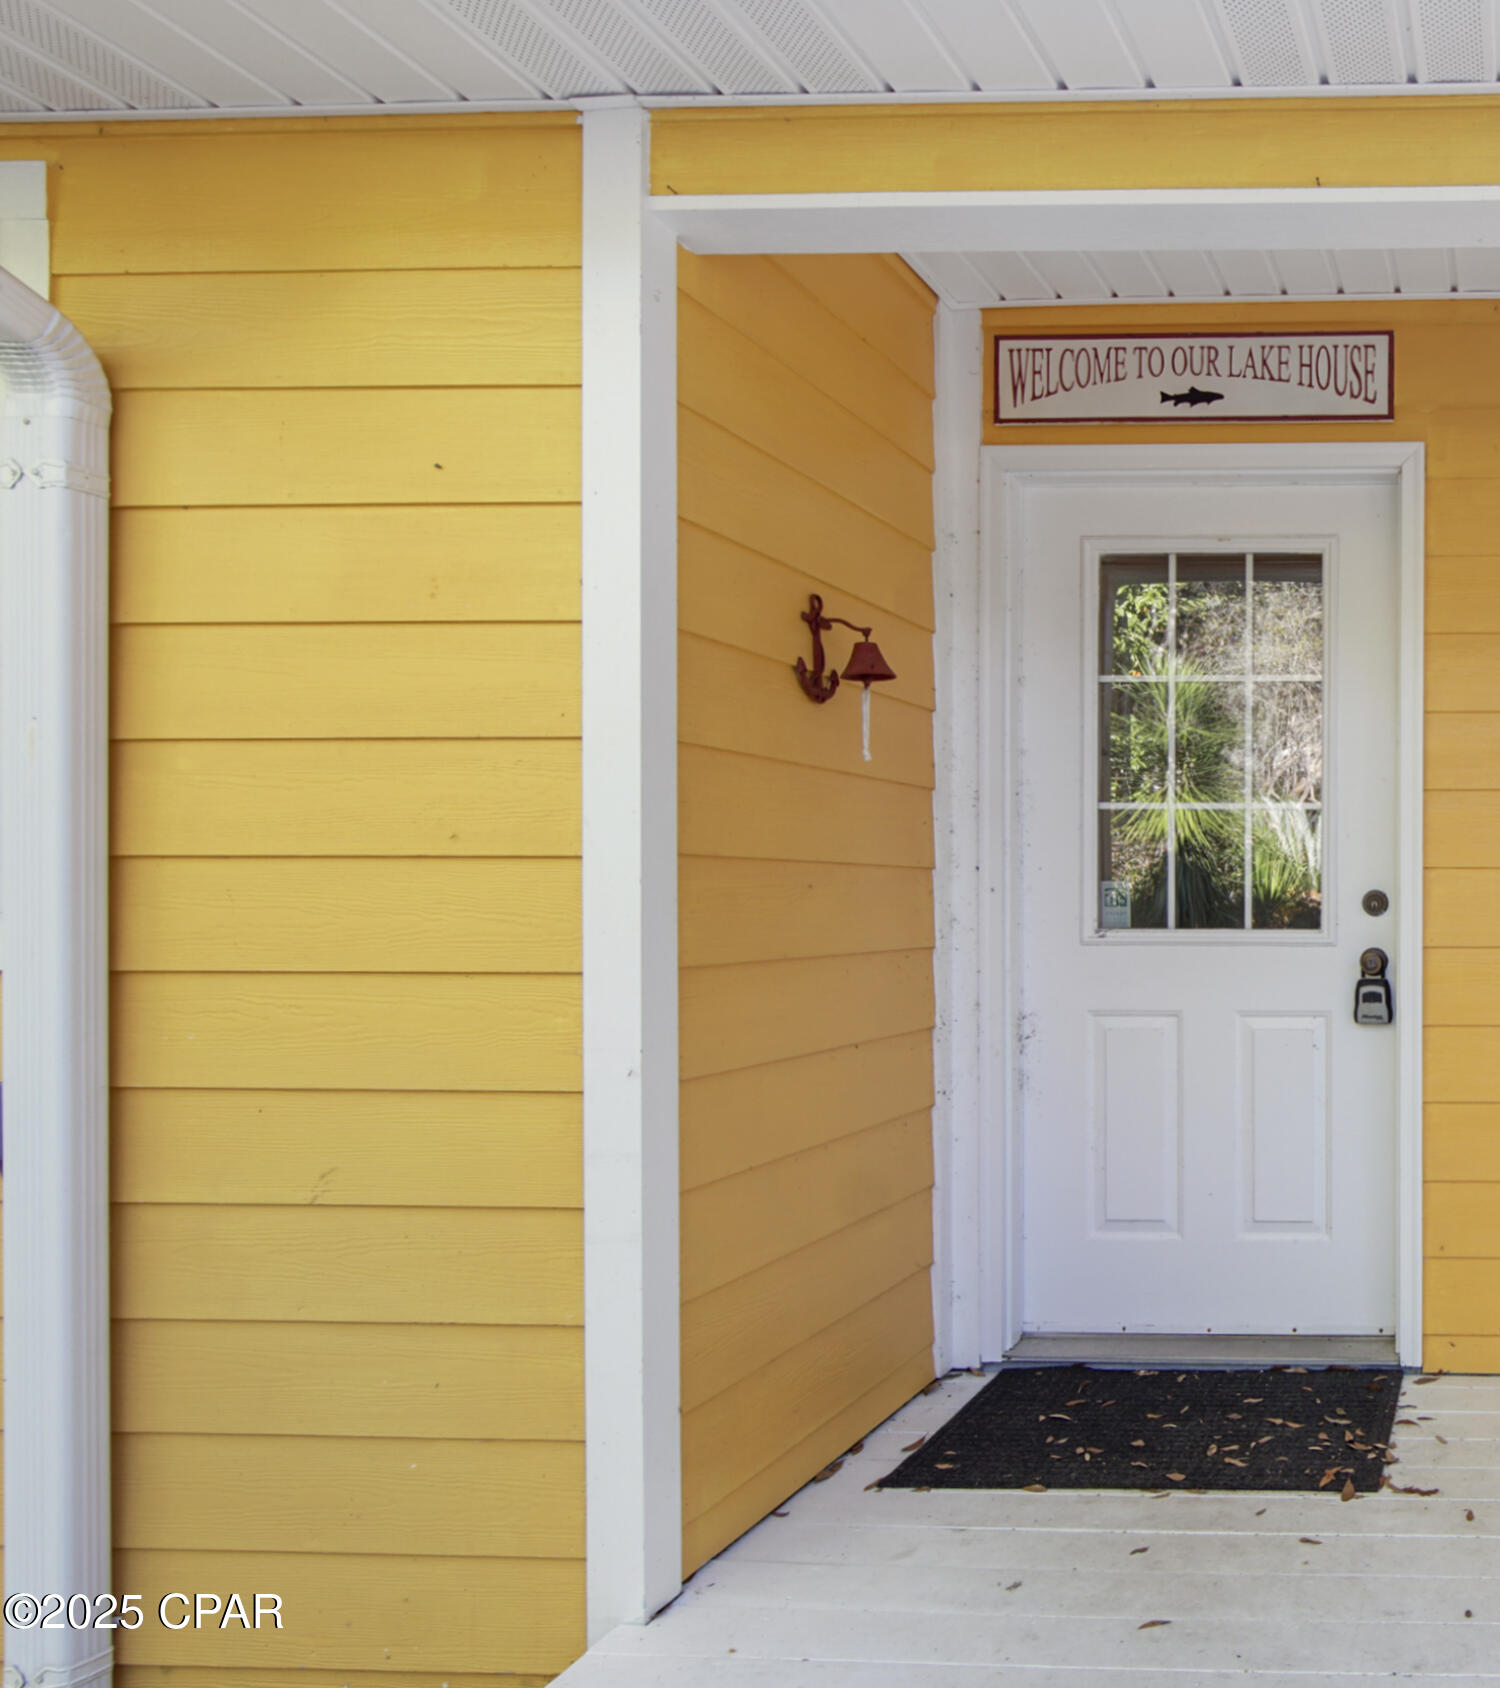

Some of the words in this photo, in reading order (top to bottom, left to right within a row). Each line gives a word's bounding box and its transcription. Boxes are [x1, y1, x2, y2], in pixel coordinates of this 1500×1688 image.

[1008, 346, 1127, 408] WELCOME
[1133, 346, 1165, 379] TO
[1171, 345, 1221, 377] OUR
[1227, 345, 1292, 383] LAKE
[1297, 344, 1378, 404] HOUSE
